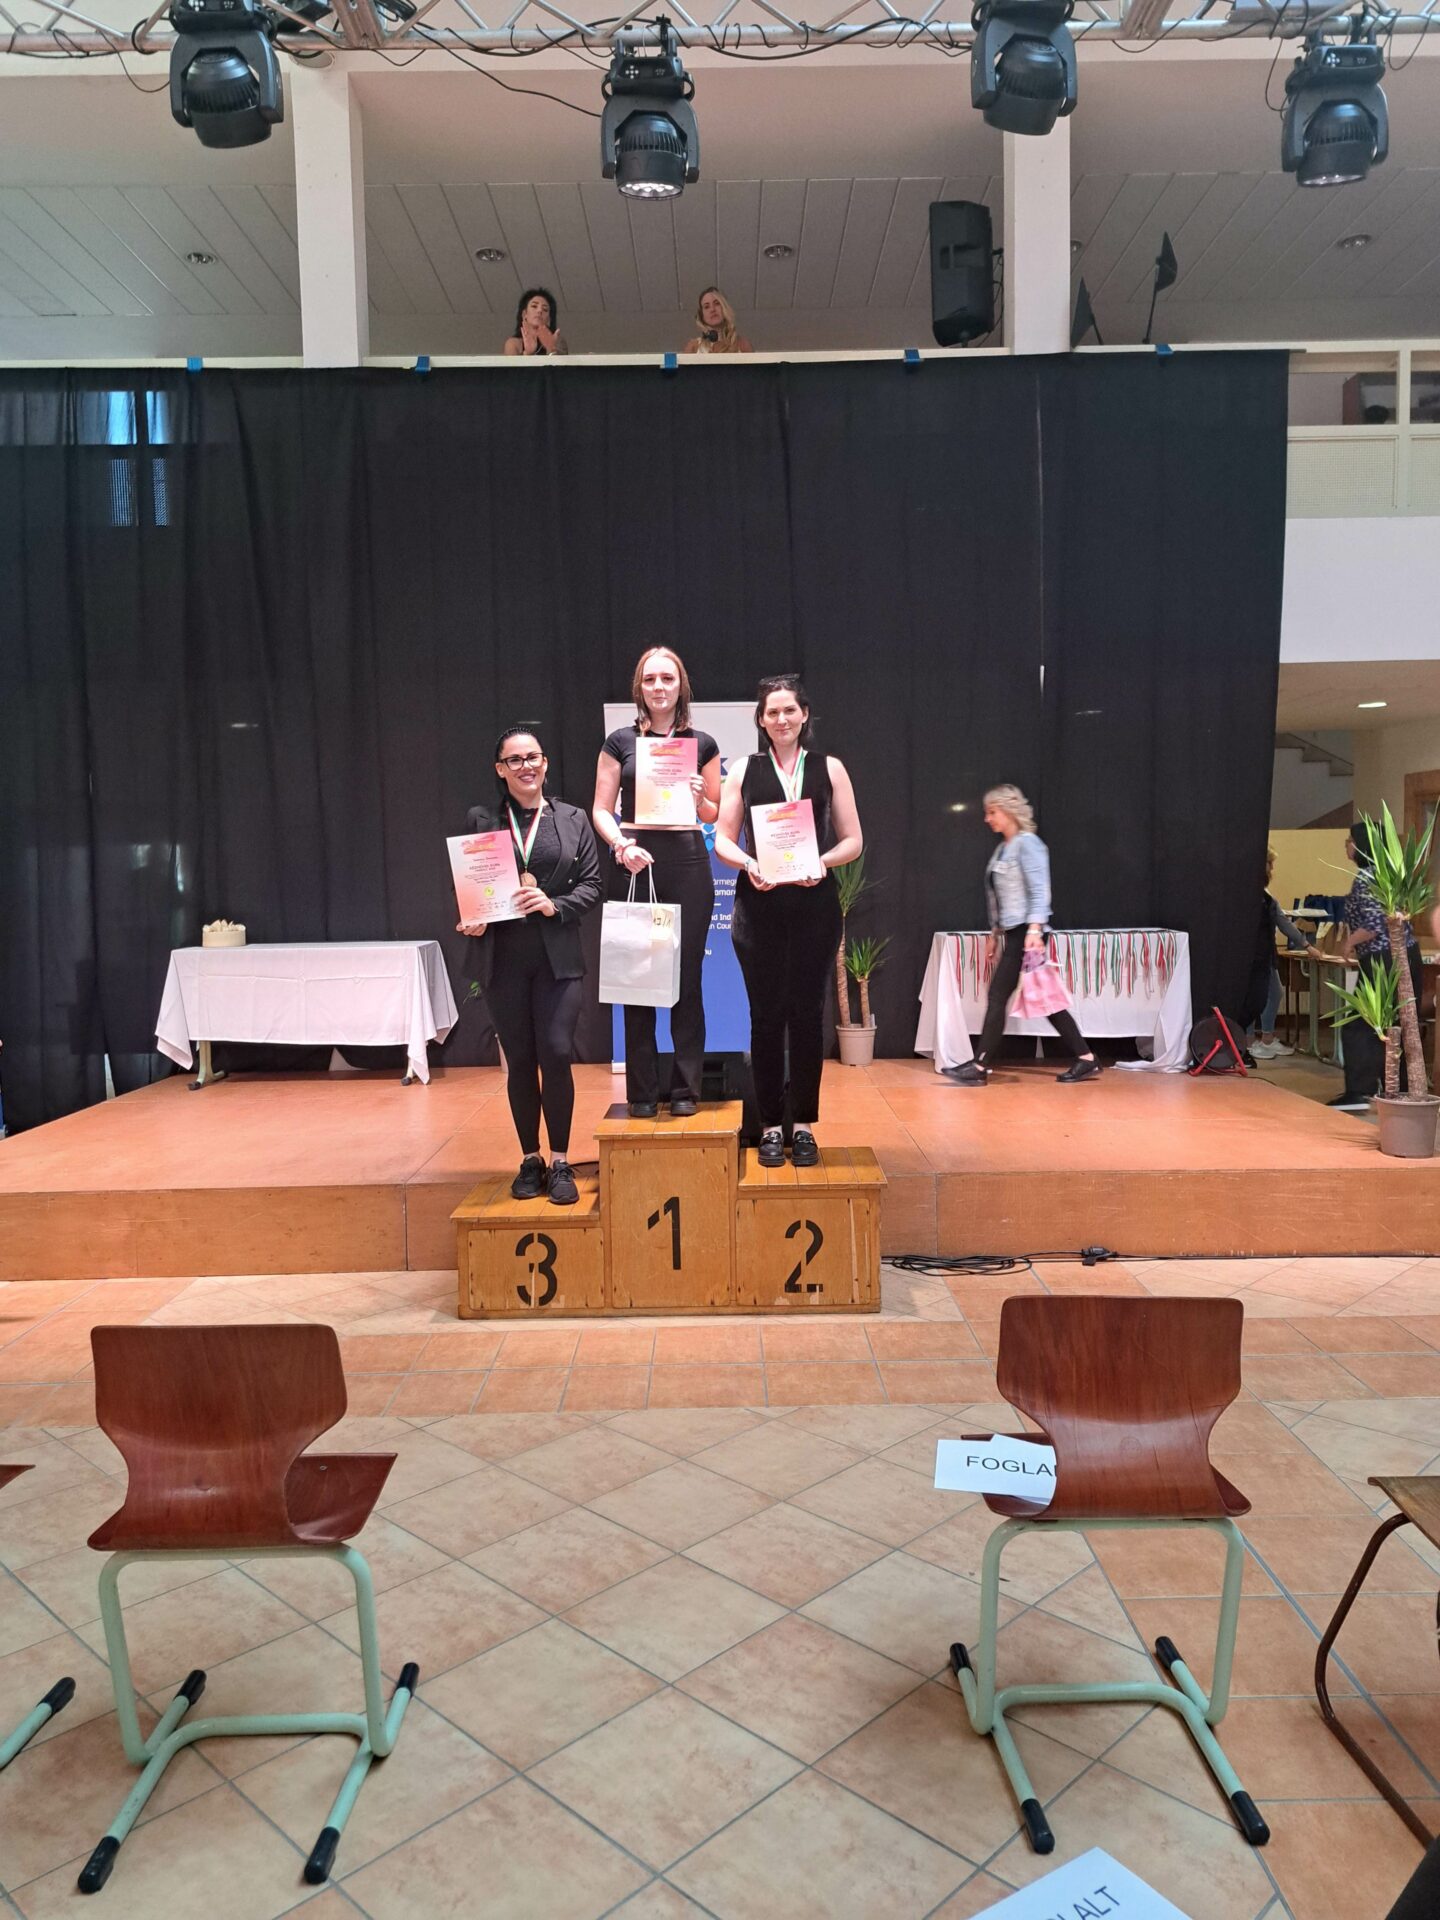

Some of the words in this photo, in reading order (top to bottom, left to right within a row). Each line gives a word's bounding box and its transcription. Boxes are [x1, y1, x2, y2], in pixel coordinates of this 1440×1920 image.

[515, 1233, 557, 1306] 3
[647, 1196, 681, 1270] 1
[784, 1220, 823, 1293] 2
[966, 1455, 1056, 1477] FOGLA
